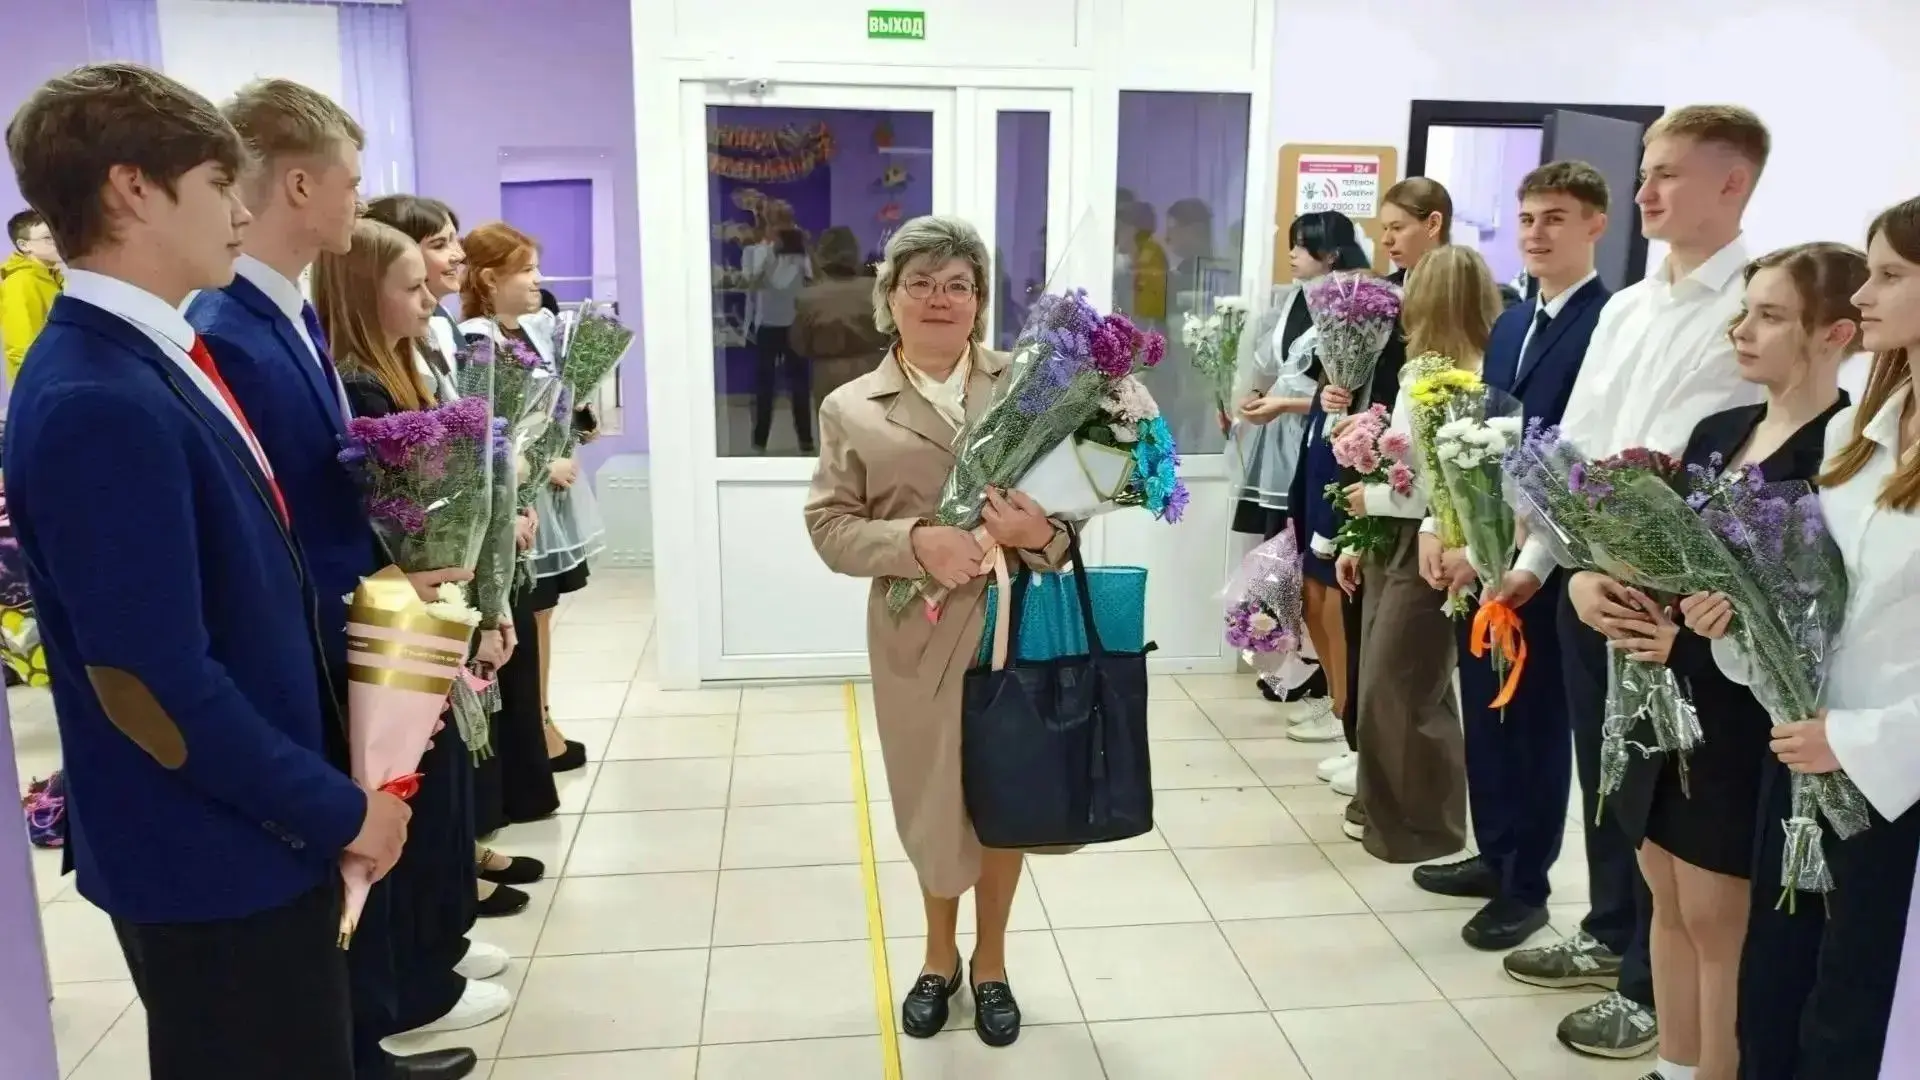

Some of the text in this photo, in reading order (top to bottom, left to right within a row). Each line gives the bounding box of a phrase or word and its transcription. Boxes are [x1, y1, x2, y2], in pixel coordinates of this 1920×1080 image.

[869, 16, 923, 37] ВЫХОД
[1304, 202, 1309, 210] 8
[1331, 202, 1354, 210] 2000
[1357, 203, 1371, 211] 122
